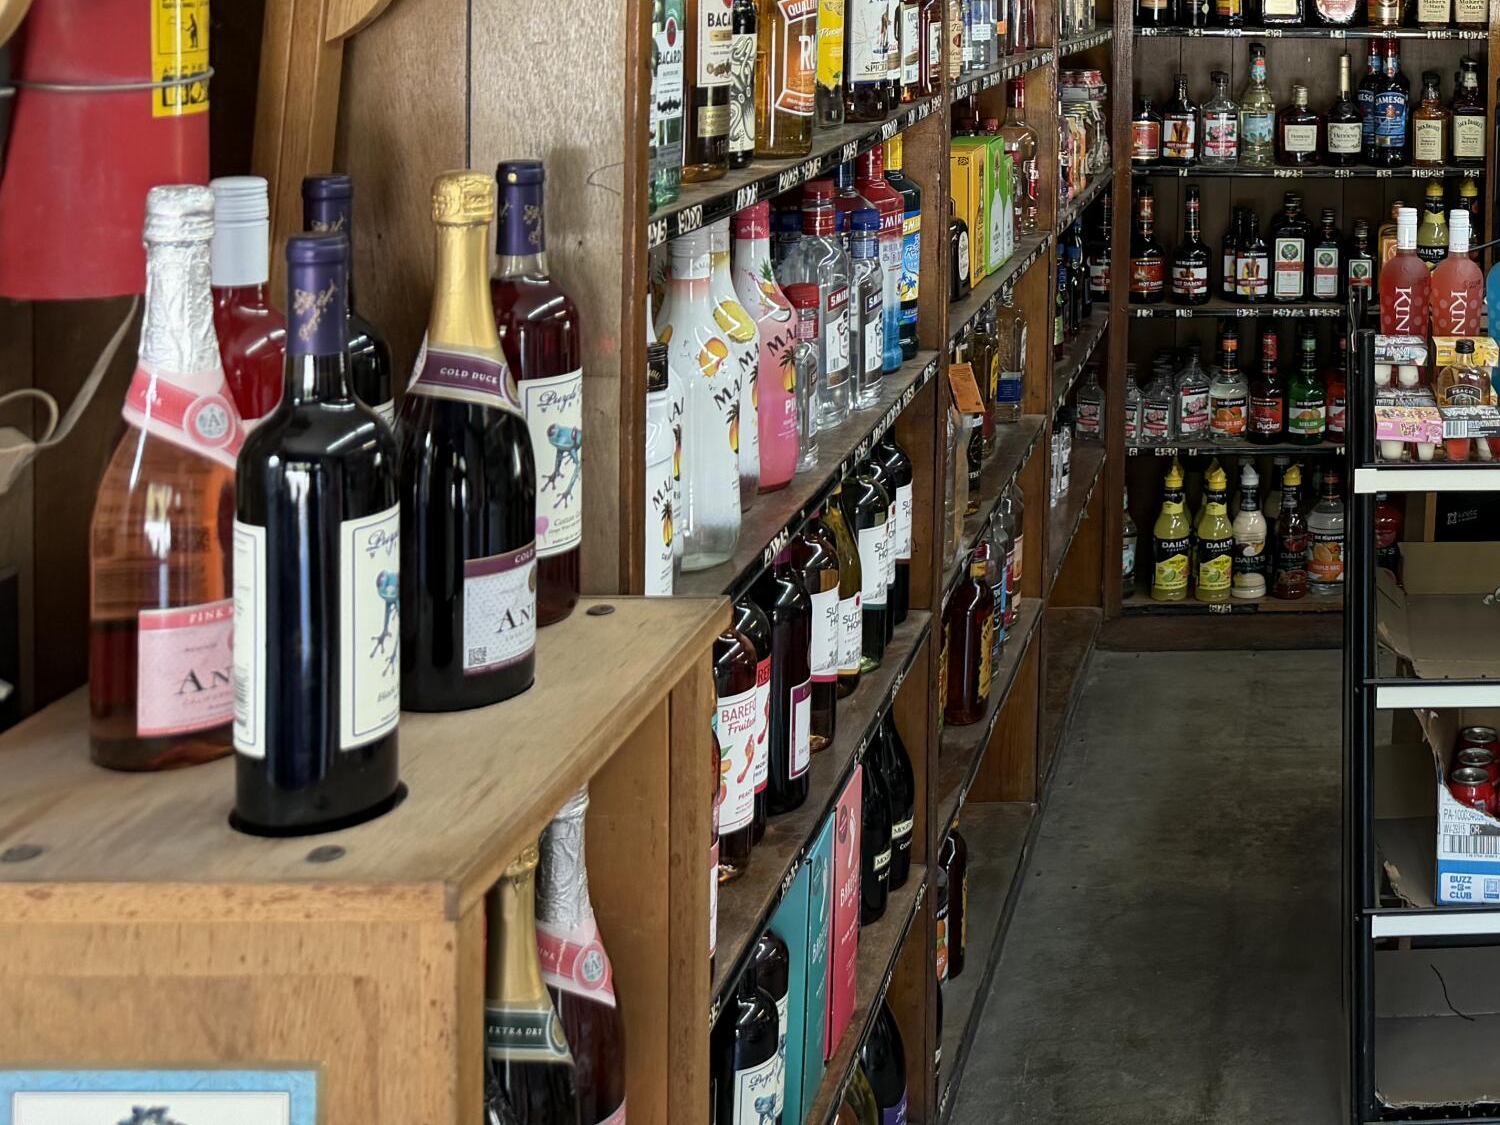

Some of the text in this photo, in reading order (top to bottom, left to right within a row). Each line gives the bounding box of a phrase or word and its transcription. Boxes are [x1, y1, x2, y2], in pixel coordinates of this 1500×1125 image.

[1383, 29, 1397, 39] 36
[1375, 94, 1405, 106] JAMESON
[439, 366, 499, 385] COLD DUCK
[1450, 387, 1475, 396] PEACH
[1256, 421, 1280, 431] Pucker
[1449, 875, 1472, 884] BUZZ
[1449, 891, 1473, 900] CLUB
[488, 1026, 544, 1039] EXTRA DRY
